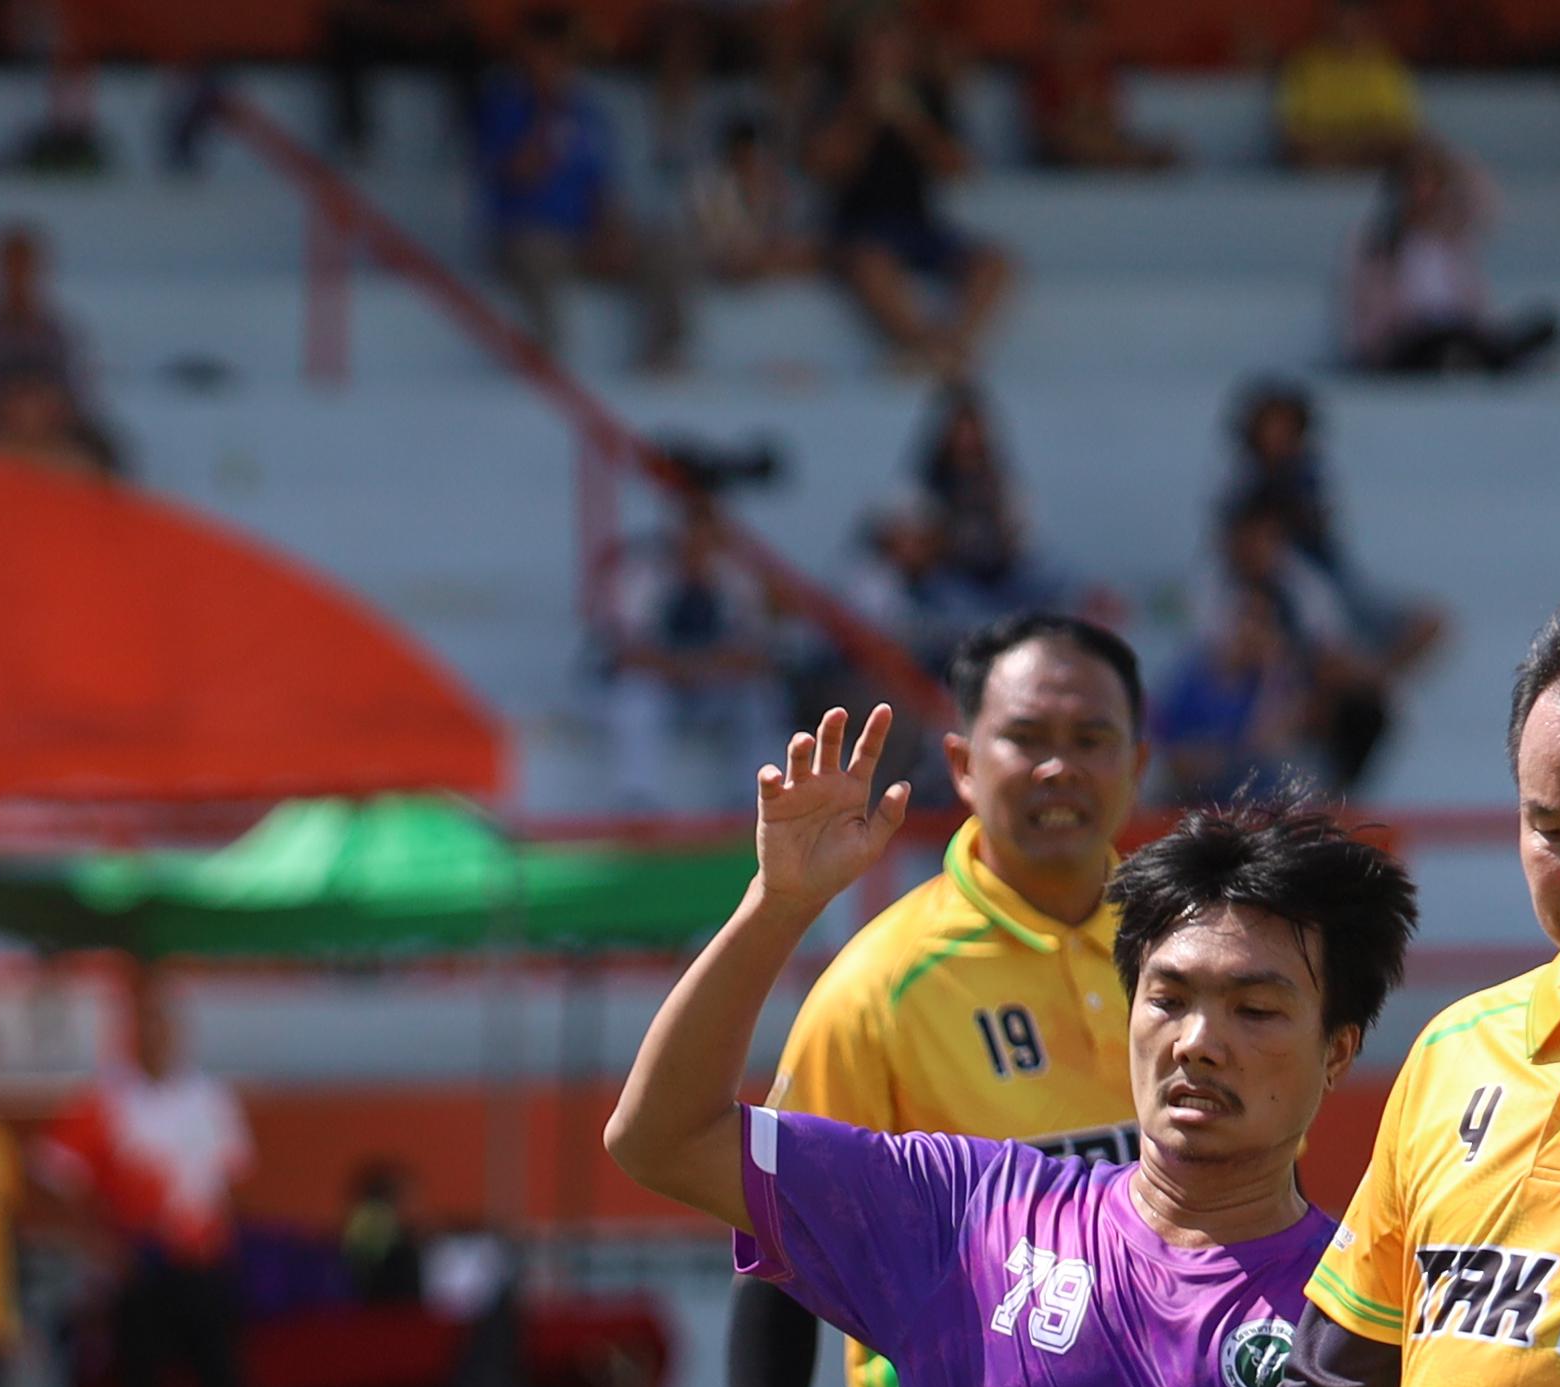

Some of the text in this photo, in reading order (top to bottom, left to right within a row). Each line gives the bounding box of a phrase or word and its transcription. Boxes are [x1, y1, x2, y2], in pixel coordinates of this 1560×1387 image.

[975, 1004, 1049, 1081] 19
[1457, 1085, 1504, 1163] 4
[991, 1236, 1094, 1355] 79
